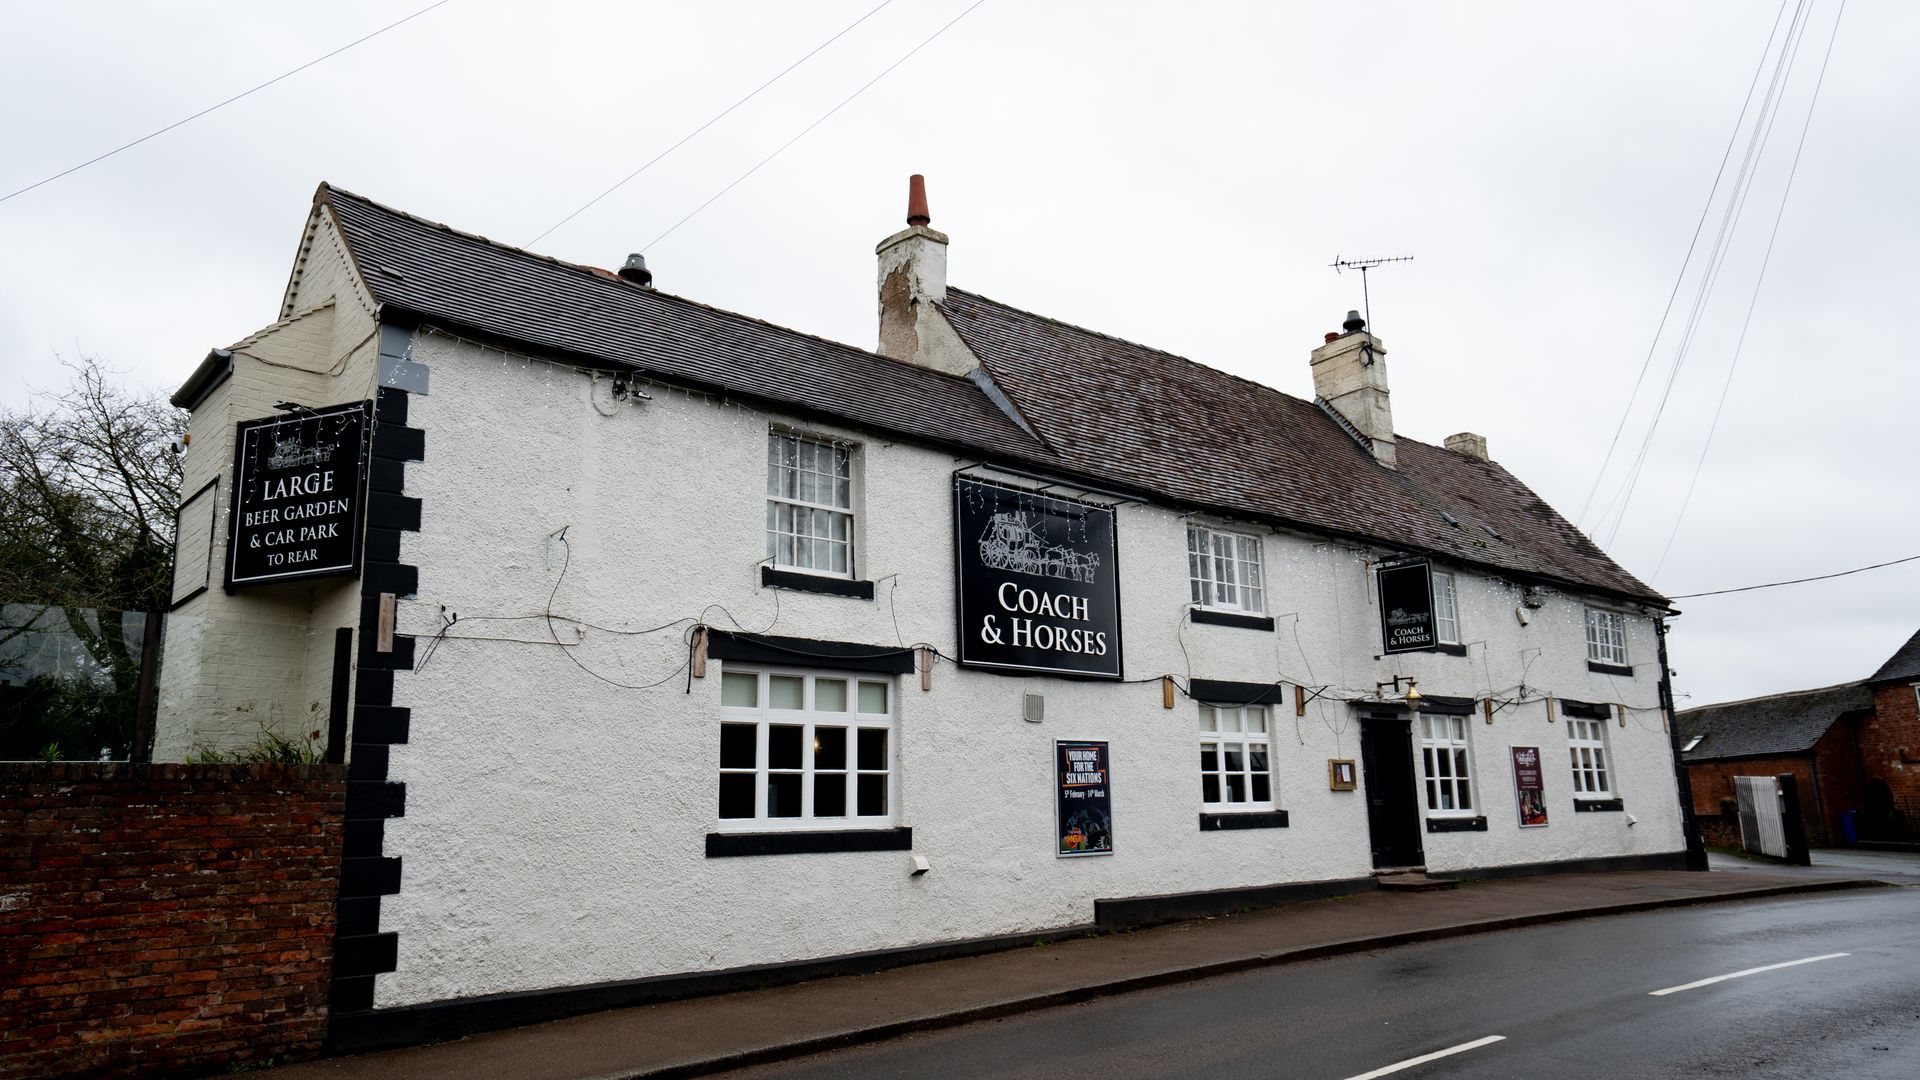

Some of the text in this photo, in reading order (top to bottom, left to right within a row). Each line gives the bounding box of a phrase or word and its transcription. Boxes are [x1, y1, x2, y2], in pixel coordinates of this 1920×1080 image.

[263, 470, 334, 501] LARGE
[245, 498, 349, 527] BEER GARDEN
[250, 522, 339, 548] & CAR PARK
[267, 548, 319, 566] TO REAR
[998, 582, 1090, 621] COACH
[981, 614, 1107, 656] & HORSES
[1390, 634, 1430, 645] & HORSES
[1394, 626, 1424, 636] COACH
[1068, 750, 1097, 761] YOUR HOME
[1073, 761, 1094, 772] FOR THE
[1066, 772, 1102, 784] SIX NATIONS
